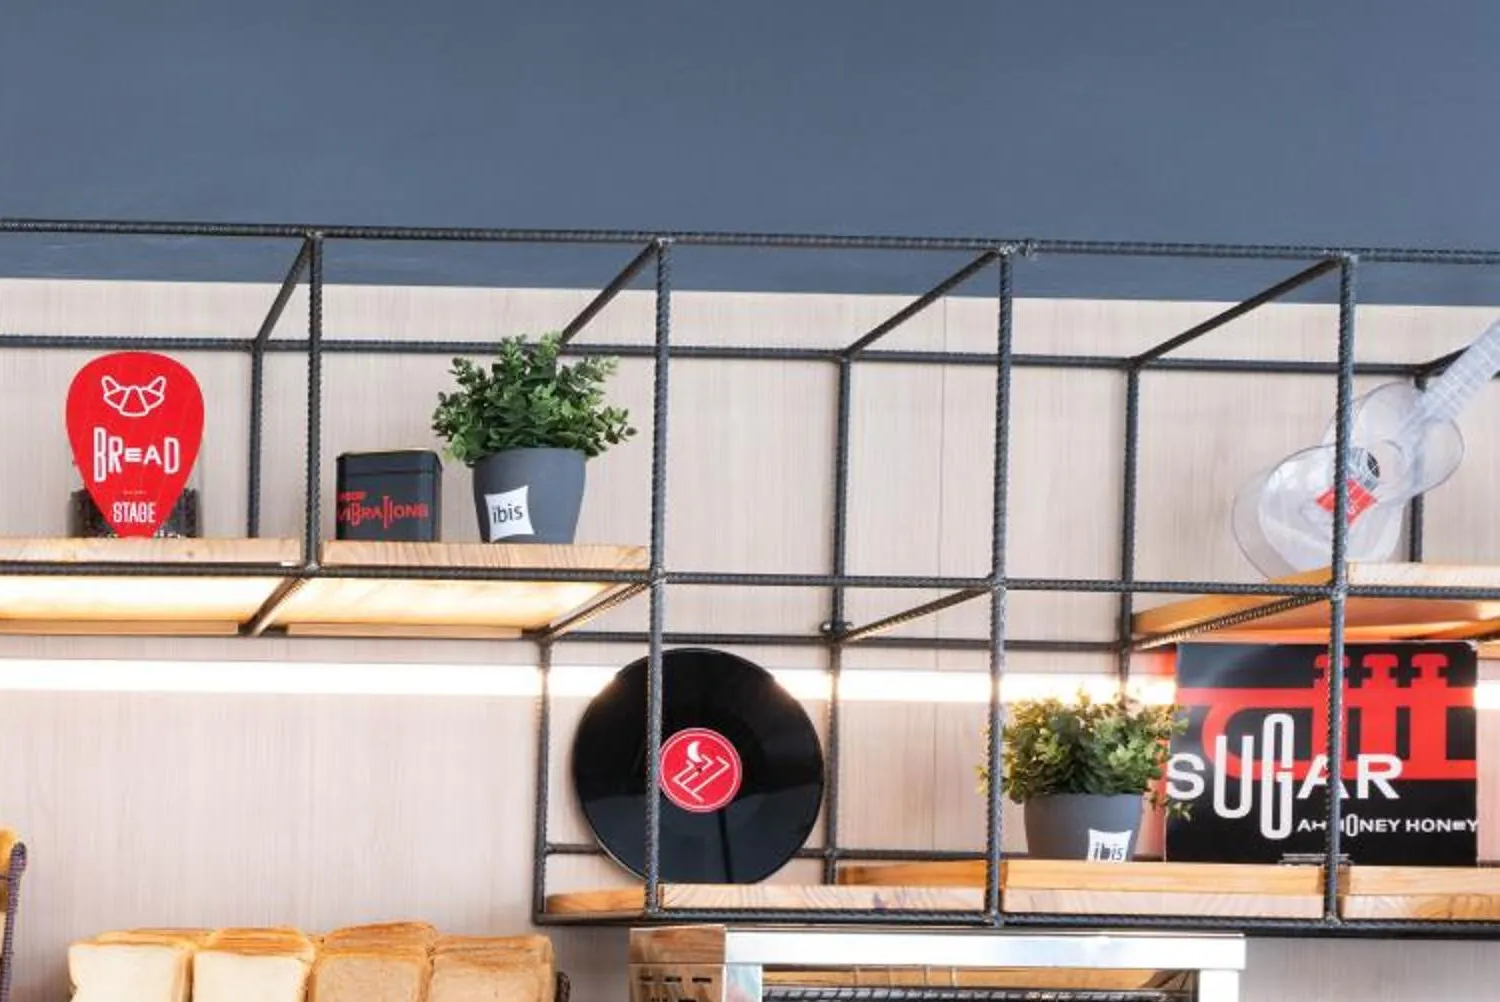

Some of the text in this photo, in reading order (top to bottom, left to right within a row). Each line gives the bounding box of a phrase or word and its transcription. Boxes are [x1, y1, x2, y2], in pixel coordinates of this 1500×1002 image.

[93, 426, 180, 483] BREAD
[112, 500, 157, 523] STAGE
[492, 502, 524, 524] ibis
[1166, 712, 1403, 840] SUGAR
[1405, 818, 1479, 833] HONEY
